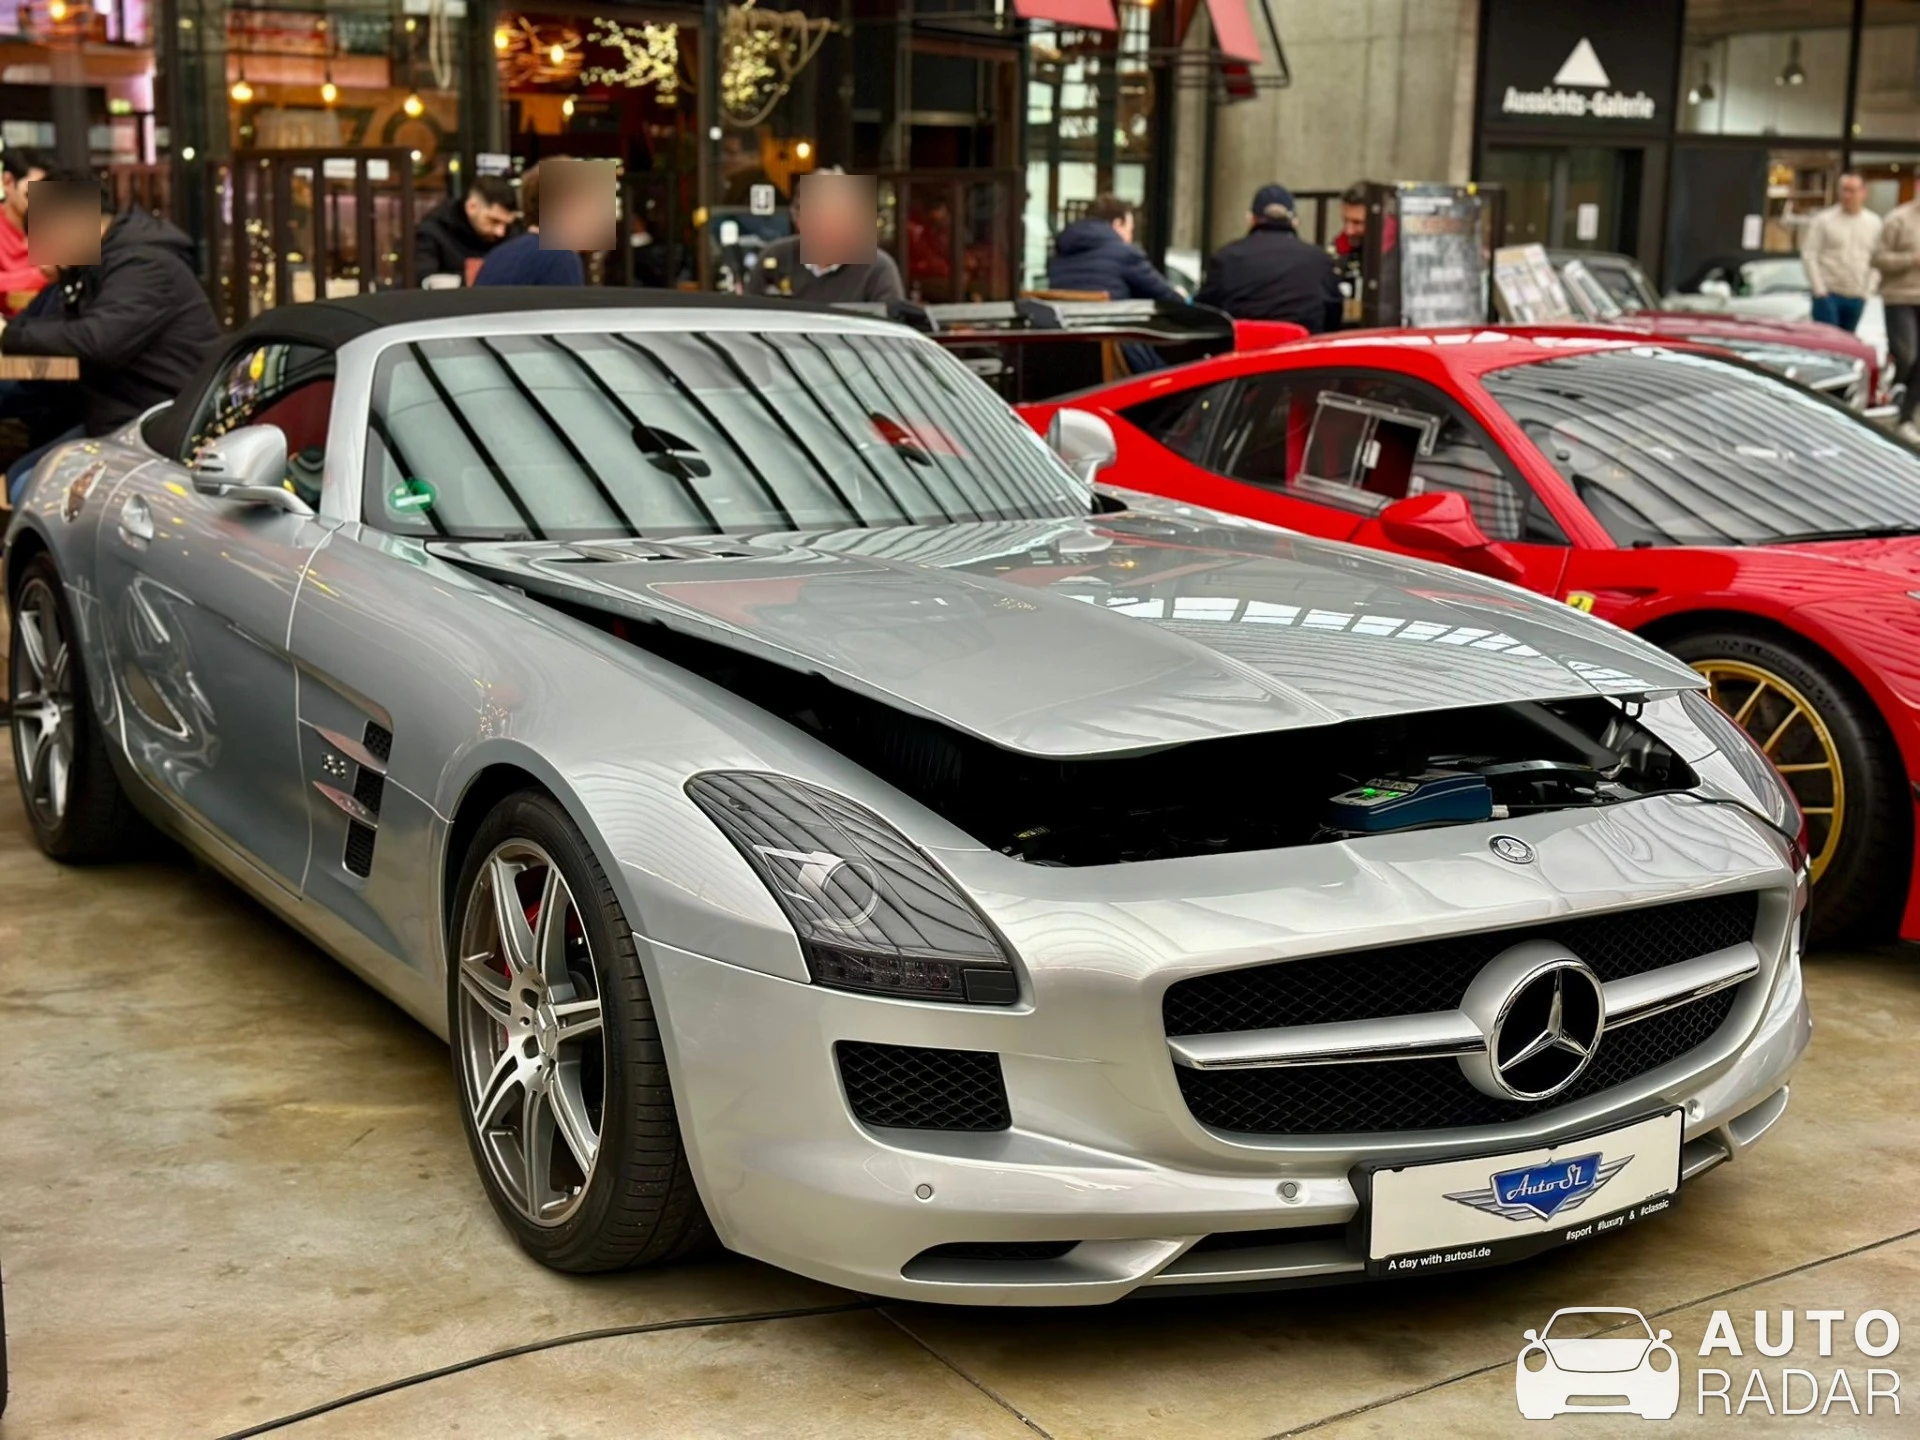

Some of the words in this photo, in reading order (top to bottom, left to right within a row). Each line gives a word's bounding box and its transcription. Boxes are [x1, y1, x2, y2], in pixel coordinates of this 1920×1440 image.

[1502, 86, 1655, 119] Aussichts-Galerie
[1566, 1225, 1592, 1240] #sport
[1597, 1215, 1625, 1231] #luxury
[1629, 1210, 1635, 1220] &
[1640, 1199, 1670, 1216] #classic
[1388, 1260, 1397, 1270] A
[1399, 1258, 1418, 1269] day
[1420, 1254, 1442, 1266] with
[1444, 1247, 1491, 1262] autosl.de
